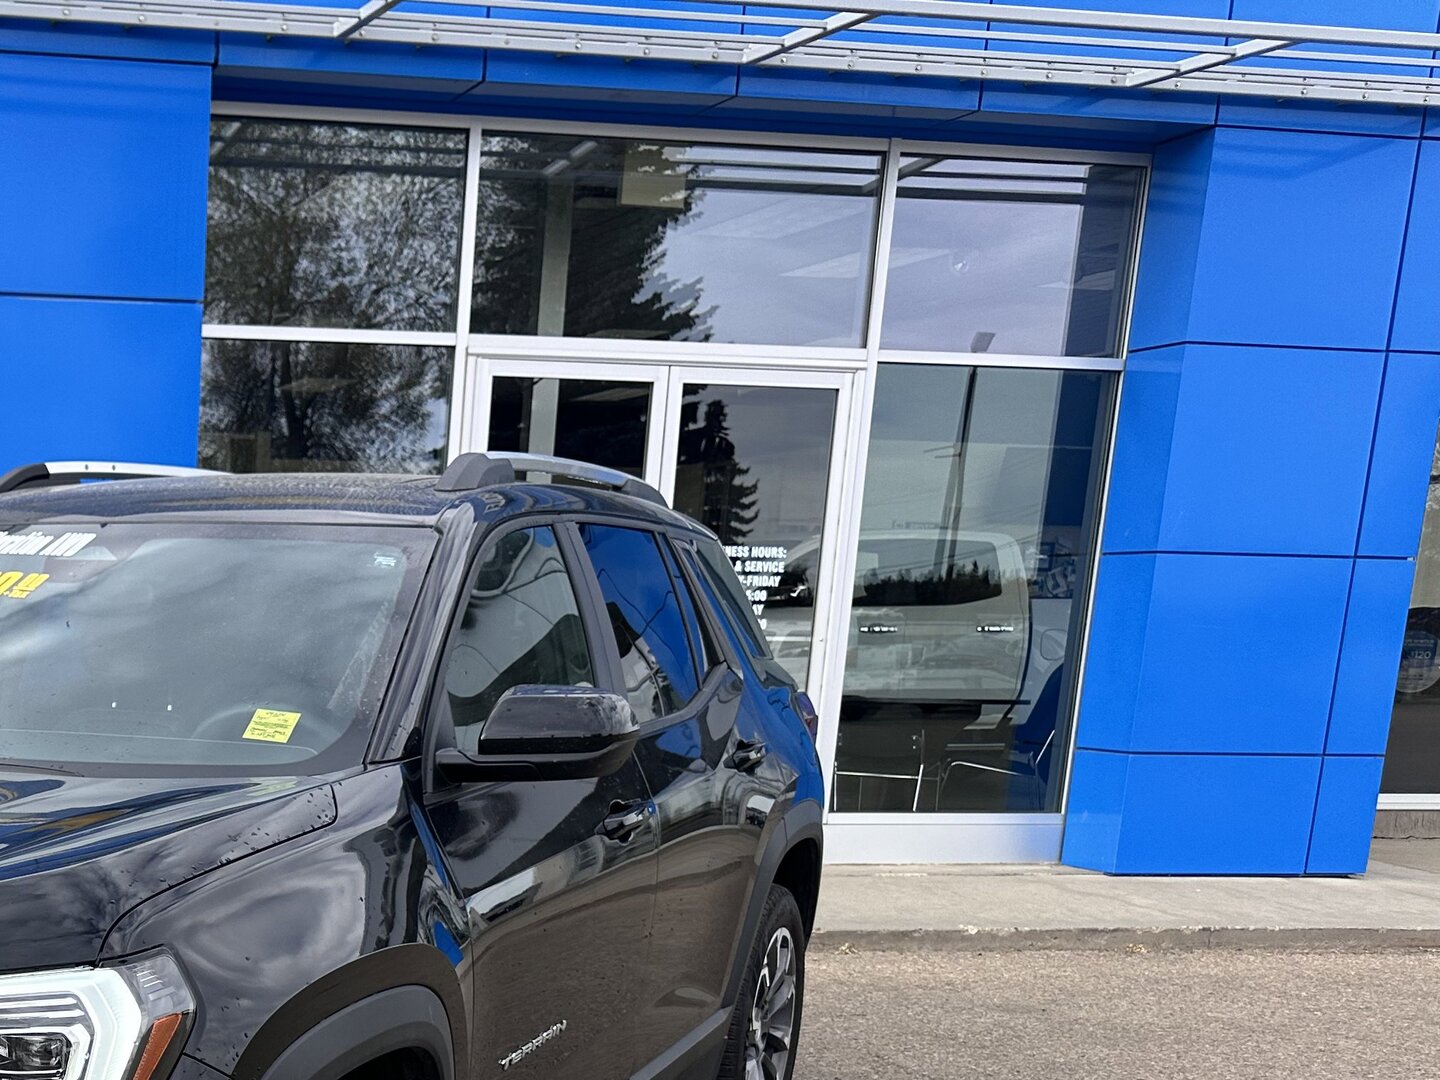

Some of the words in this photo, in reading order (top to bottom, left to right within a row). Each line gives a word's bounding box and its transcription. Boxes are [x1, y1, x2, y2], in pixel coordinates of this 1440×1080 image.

[38, 532, 97, 557] AWD
[723, 546, 749, 557] NESS
[751, 546, 787, 558] HOURS:
[744, 561, 785, 573] SERVICE
[738, 575, 781, 587] Y-FRIDAY
[498, 1020, 567, 1070] TERRAIN
